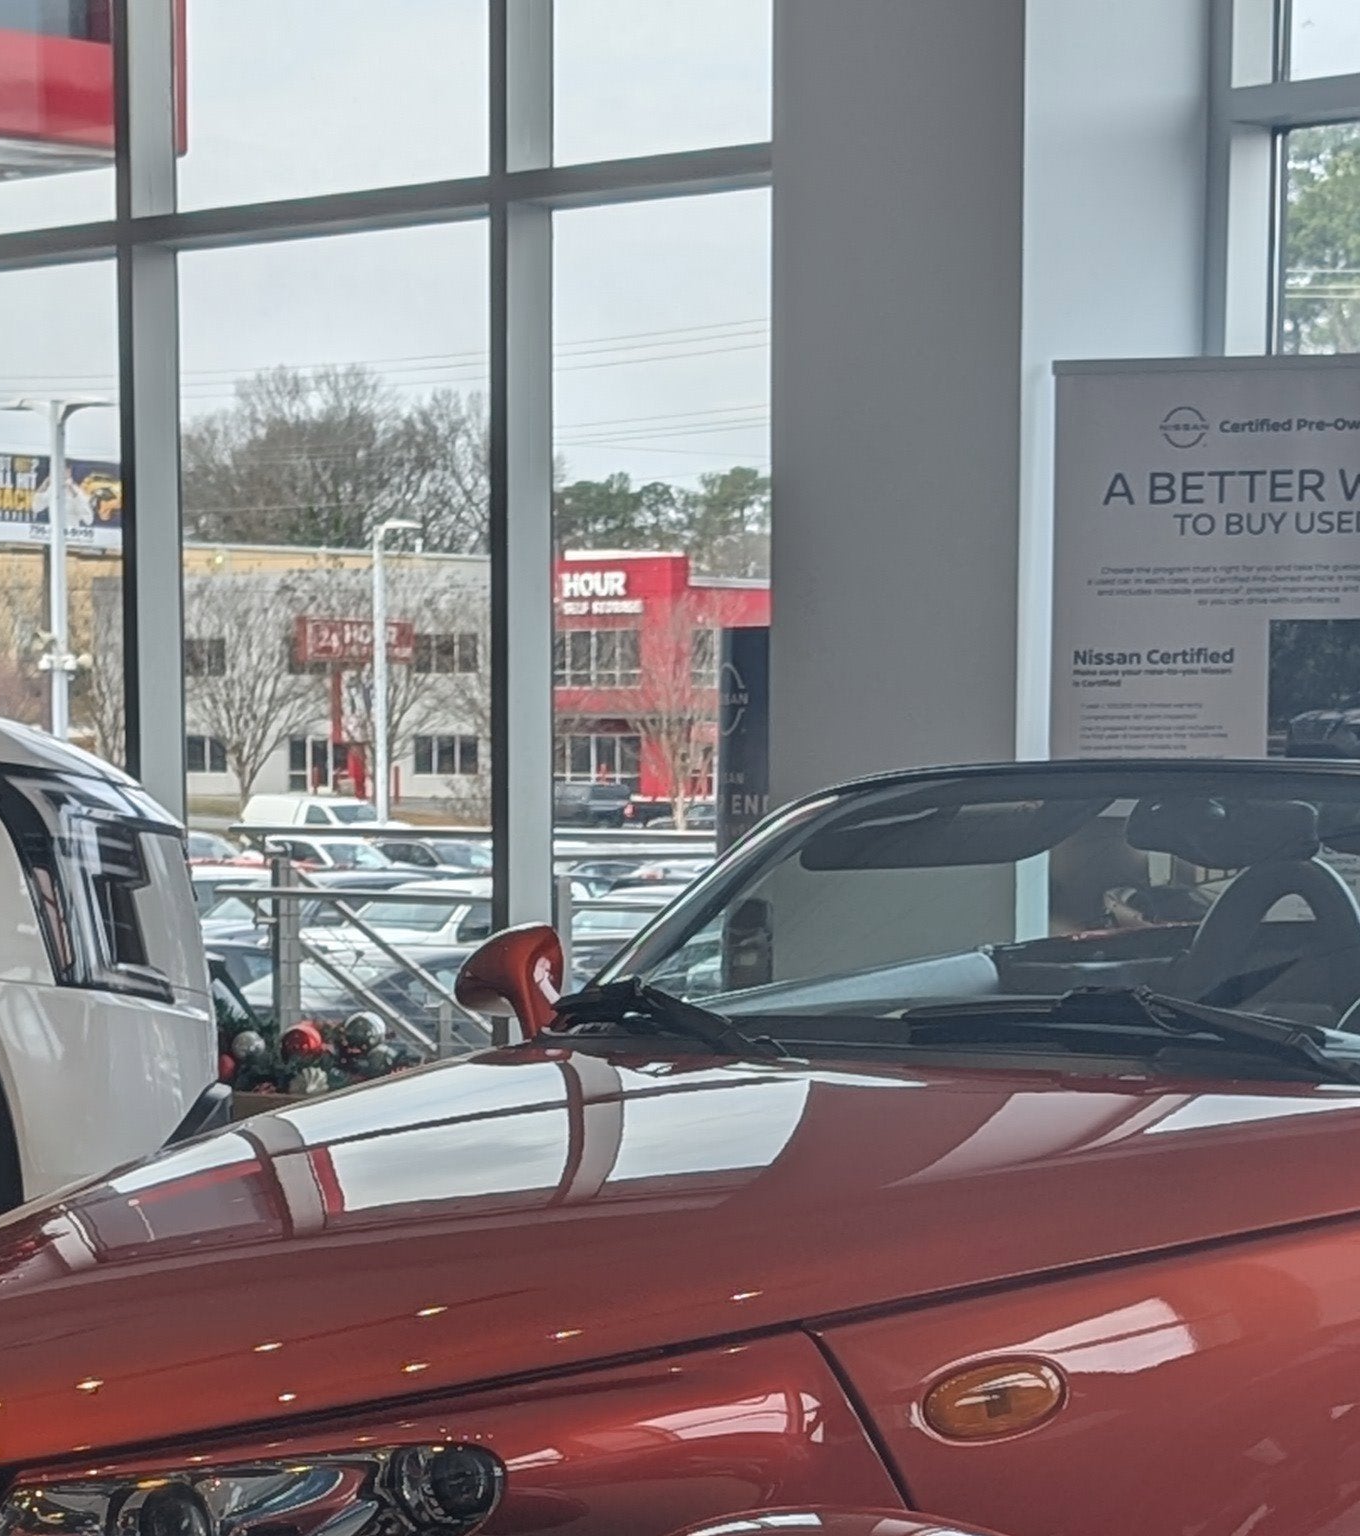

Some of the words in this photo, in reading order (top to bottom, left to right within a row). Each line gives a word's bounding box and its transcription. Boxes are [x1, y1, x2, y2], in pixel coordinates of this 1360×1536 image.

[1158, 423, 1210, 432] NISSAN
[1218, 418, 1293, 434] Certified
[1102, 472, 1135, 506] A
[1148, 469, 1326, 505] BETTER
[1173, 514, 1216, 536] TO
[1224, 512, 1287, 536] BUY
[561, 571, 627, 598] HOUR
[1072, 649, 1142, 666] Nissan
[1146, 647, 1236, 665] Certified
